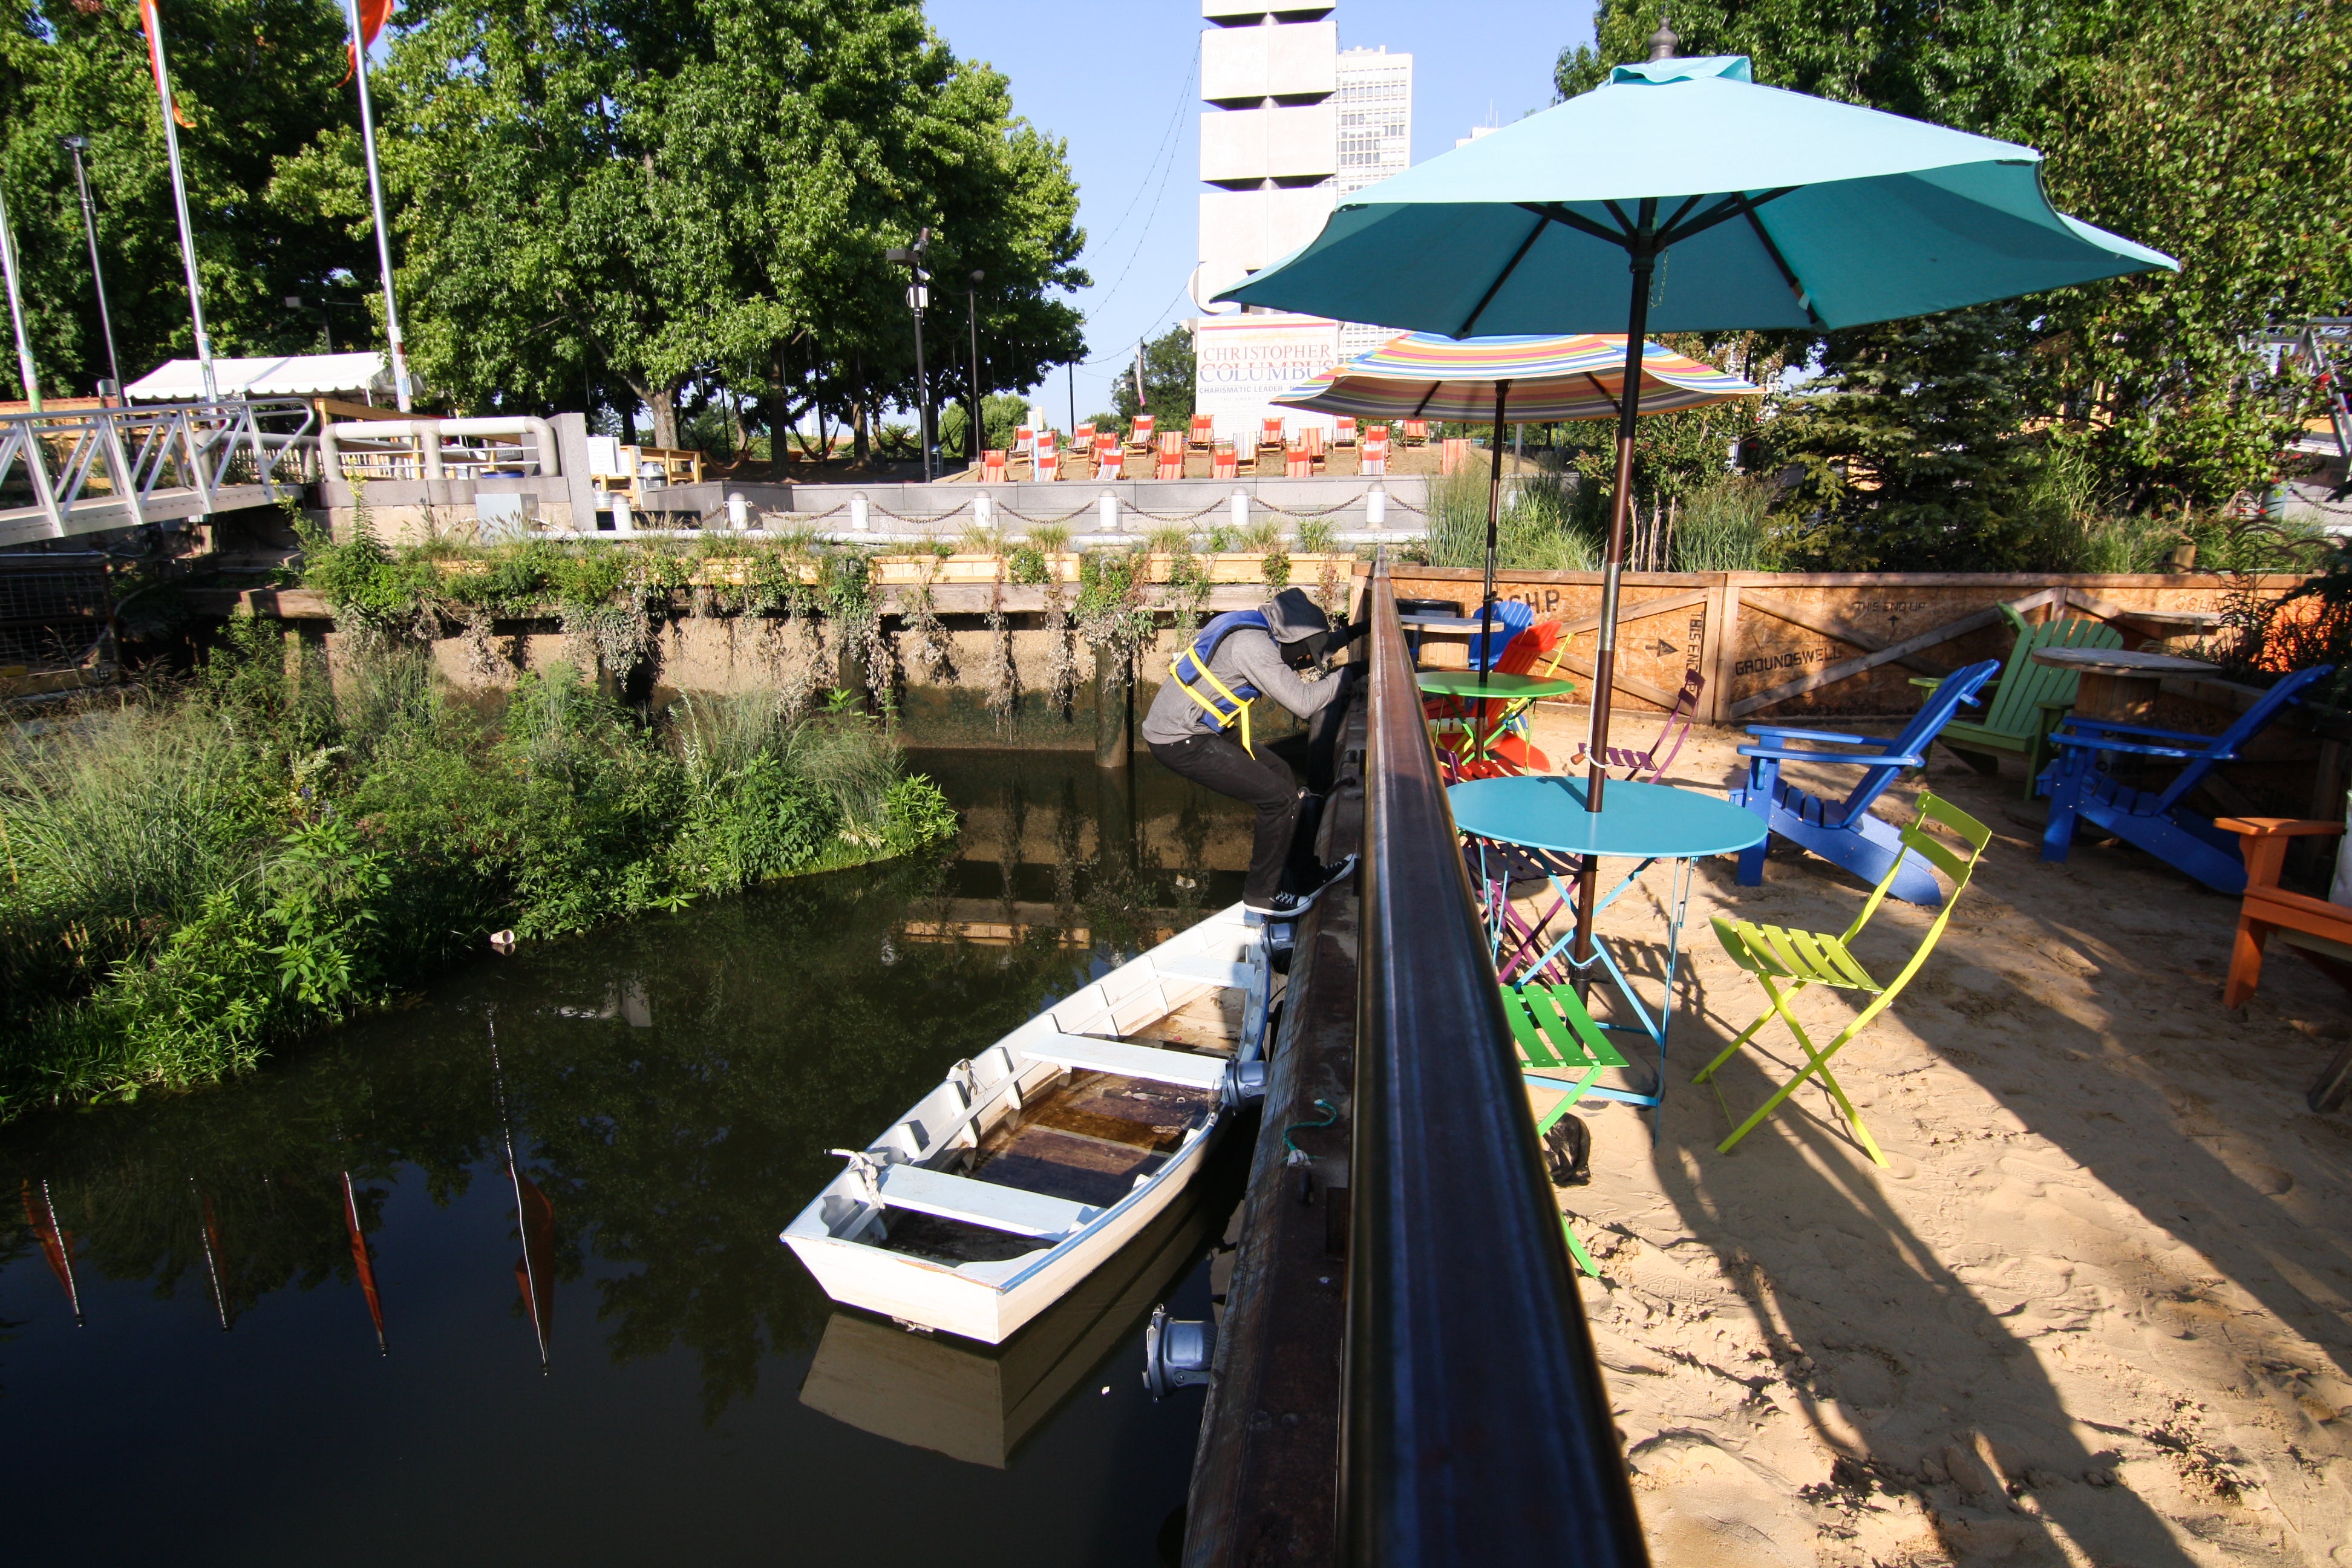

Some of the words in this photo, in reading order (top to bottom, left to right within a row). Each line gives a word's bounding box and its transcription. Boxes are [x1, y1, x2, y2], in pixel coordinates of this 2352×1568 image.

[1203, 344, 1331, 361] CHRISTOPHER
[1200, 360, 1334, 382] COLUMBUS
[1853, 601, 1878, 612] THIS
[1883, 601, 1907, 612] END
[1909, 601, 1926, 612] UP
[1689, 611, 1704, 641] THIS
[1686, 645, 1700, 671] END
[1735, 645, 1841, 675] GROUNDSWELL
